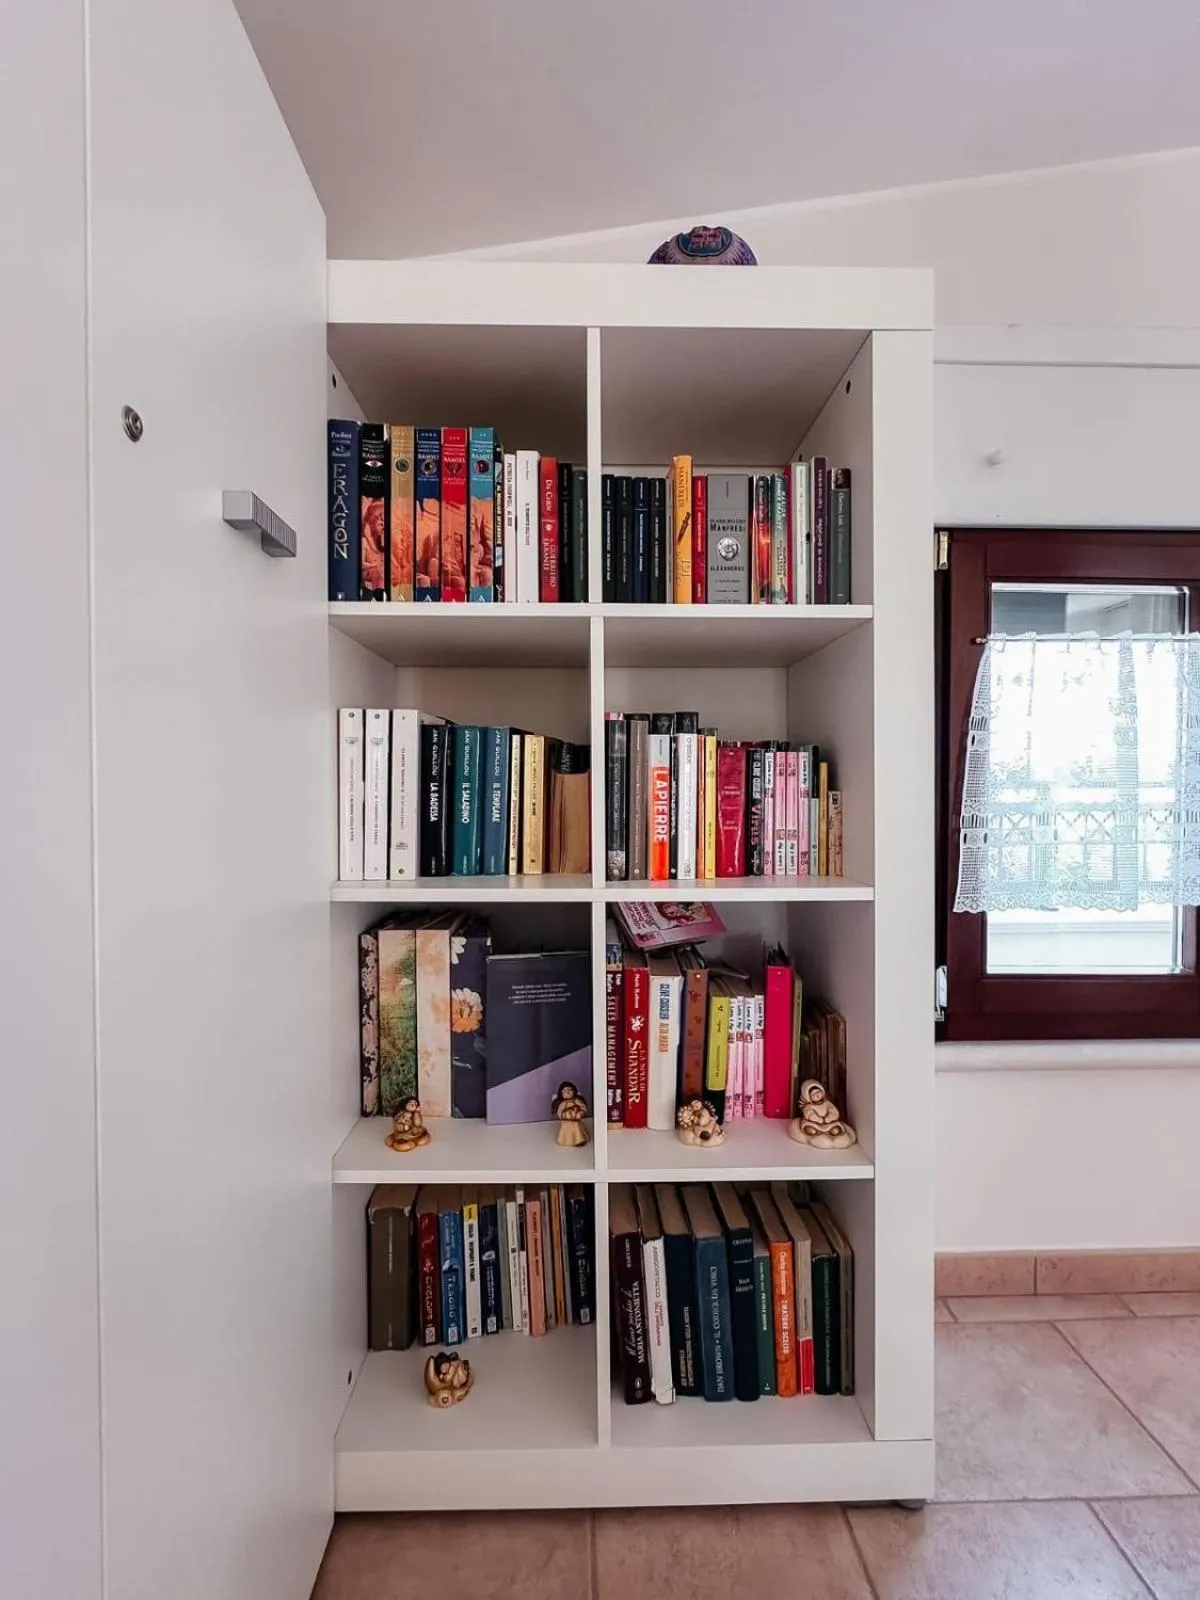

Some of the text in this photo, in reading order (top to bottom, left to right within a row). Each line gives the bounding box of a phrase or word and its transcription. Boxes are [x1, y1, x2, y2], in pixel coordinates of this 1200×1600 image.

[333, 463, 349, 560] ERAGON
[710, 523, 746, 533] MANFREDI
[431, 744, 439, 776] GUILLOU
[430, 782, 439, 792] LA
[430, 792, 439, 822] BADESSA
[461, 790, 470, 825] SALADINO
[492, 790, 501, 823] TEMPLARE
[653, 769, 668, 842] LAPIERRE
[751, 803, 761, 845] Virus
[659, 983, 670, 1020] CLIVE CUSSLER
[607, 995, 616, 1087] SALES MANAGEMENT
[659, 1022, 669, 1035] ALTA
[627, 1037, 643, 1107] SHANDAR
[709, 1265, 718, 1288] VINCI
[711, 1288, 719, 1299] DA
[631, 1280, 646, 1364] MARIA ANTONIETTA
[712, 1300, 721, 1330] CODICE
[782, 1331, 791, 1354] SCELTO
[715, 1344, 724, 1375] BROWN
[717, 1375, 726, 1393] DAN
